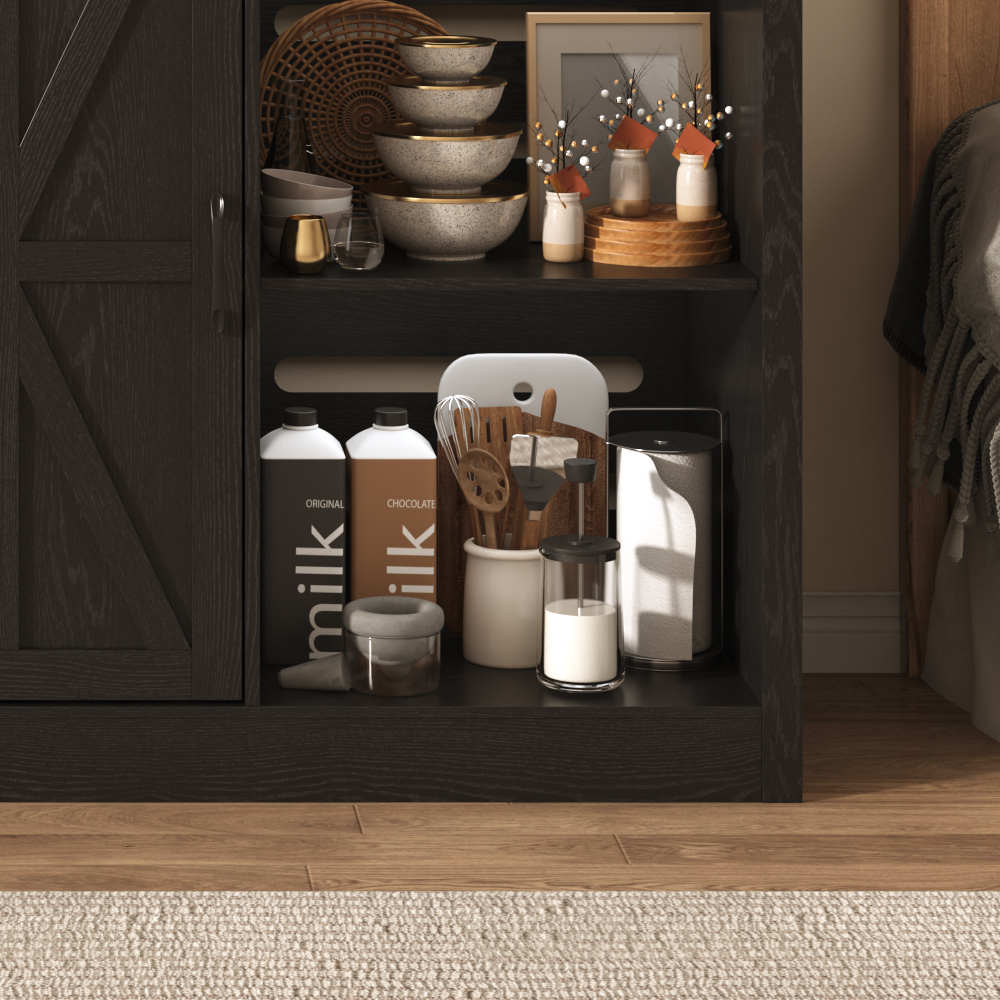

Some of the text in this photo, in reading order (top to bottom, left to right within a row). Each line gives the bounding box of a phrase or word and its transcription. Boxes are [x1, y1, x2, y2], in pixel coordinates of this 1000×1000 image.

[305, 499, 345, 509] ORIGINAL
[387, 499, 436, 509] CHOCOLATE
[386, 523, 436, 594] ilk
[295, 523, 345, 660] milk
